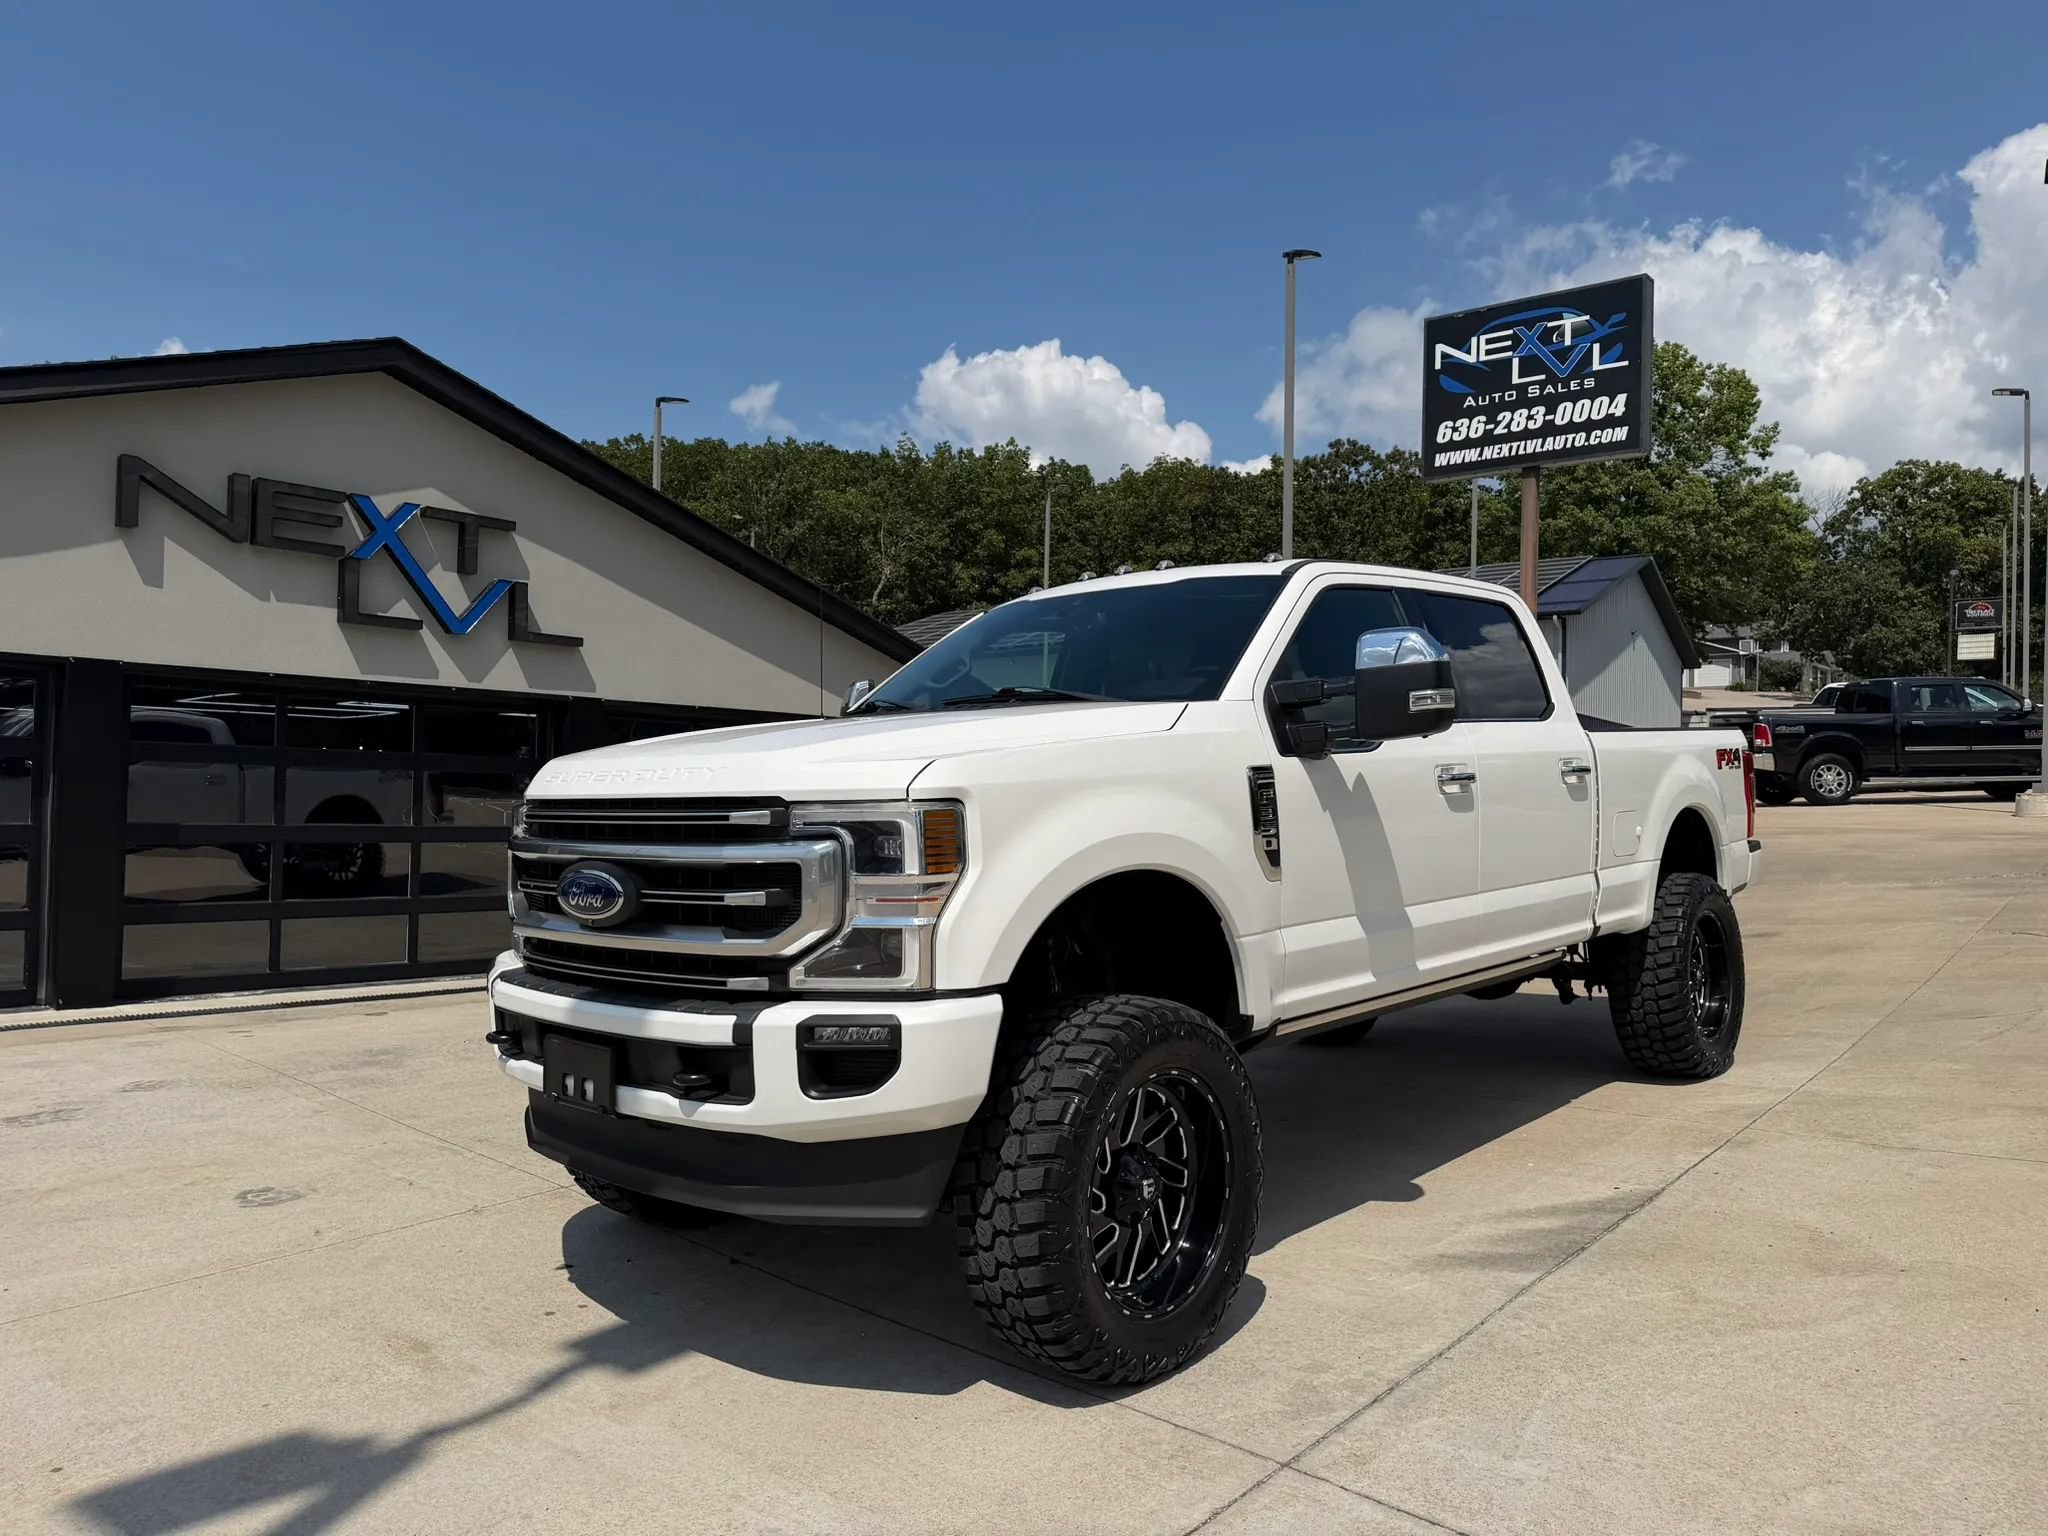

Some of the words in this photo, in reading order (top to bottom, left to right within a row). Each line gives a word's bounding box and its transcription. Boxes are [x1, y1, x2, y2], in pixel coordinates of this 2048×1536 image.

[1434, 315, 1591, 370] NEXT
[1512, 343, 1629, 384] LVL
[1463, 390, 1517, 408] AUTO
[1527, 378, 1595, 397] SALES
[1436, 393, 1628, 443] 636-283-0004
[1434, 426, 1629, 467] WWW.NEXTLVLAUTO.COM
[115, 454, 516, 575] NEXT
[337, 556, 583, 647] LVL
[545, 770, 629, 785] SUPER
[631, 766, 727, 783] DUTY
[1716, 747, 1741, 770] FX4
[568, 879, 605, 908] Ford
